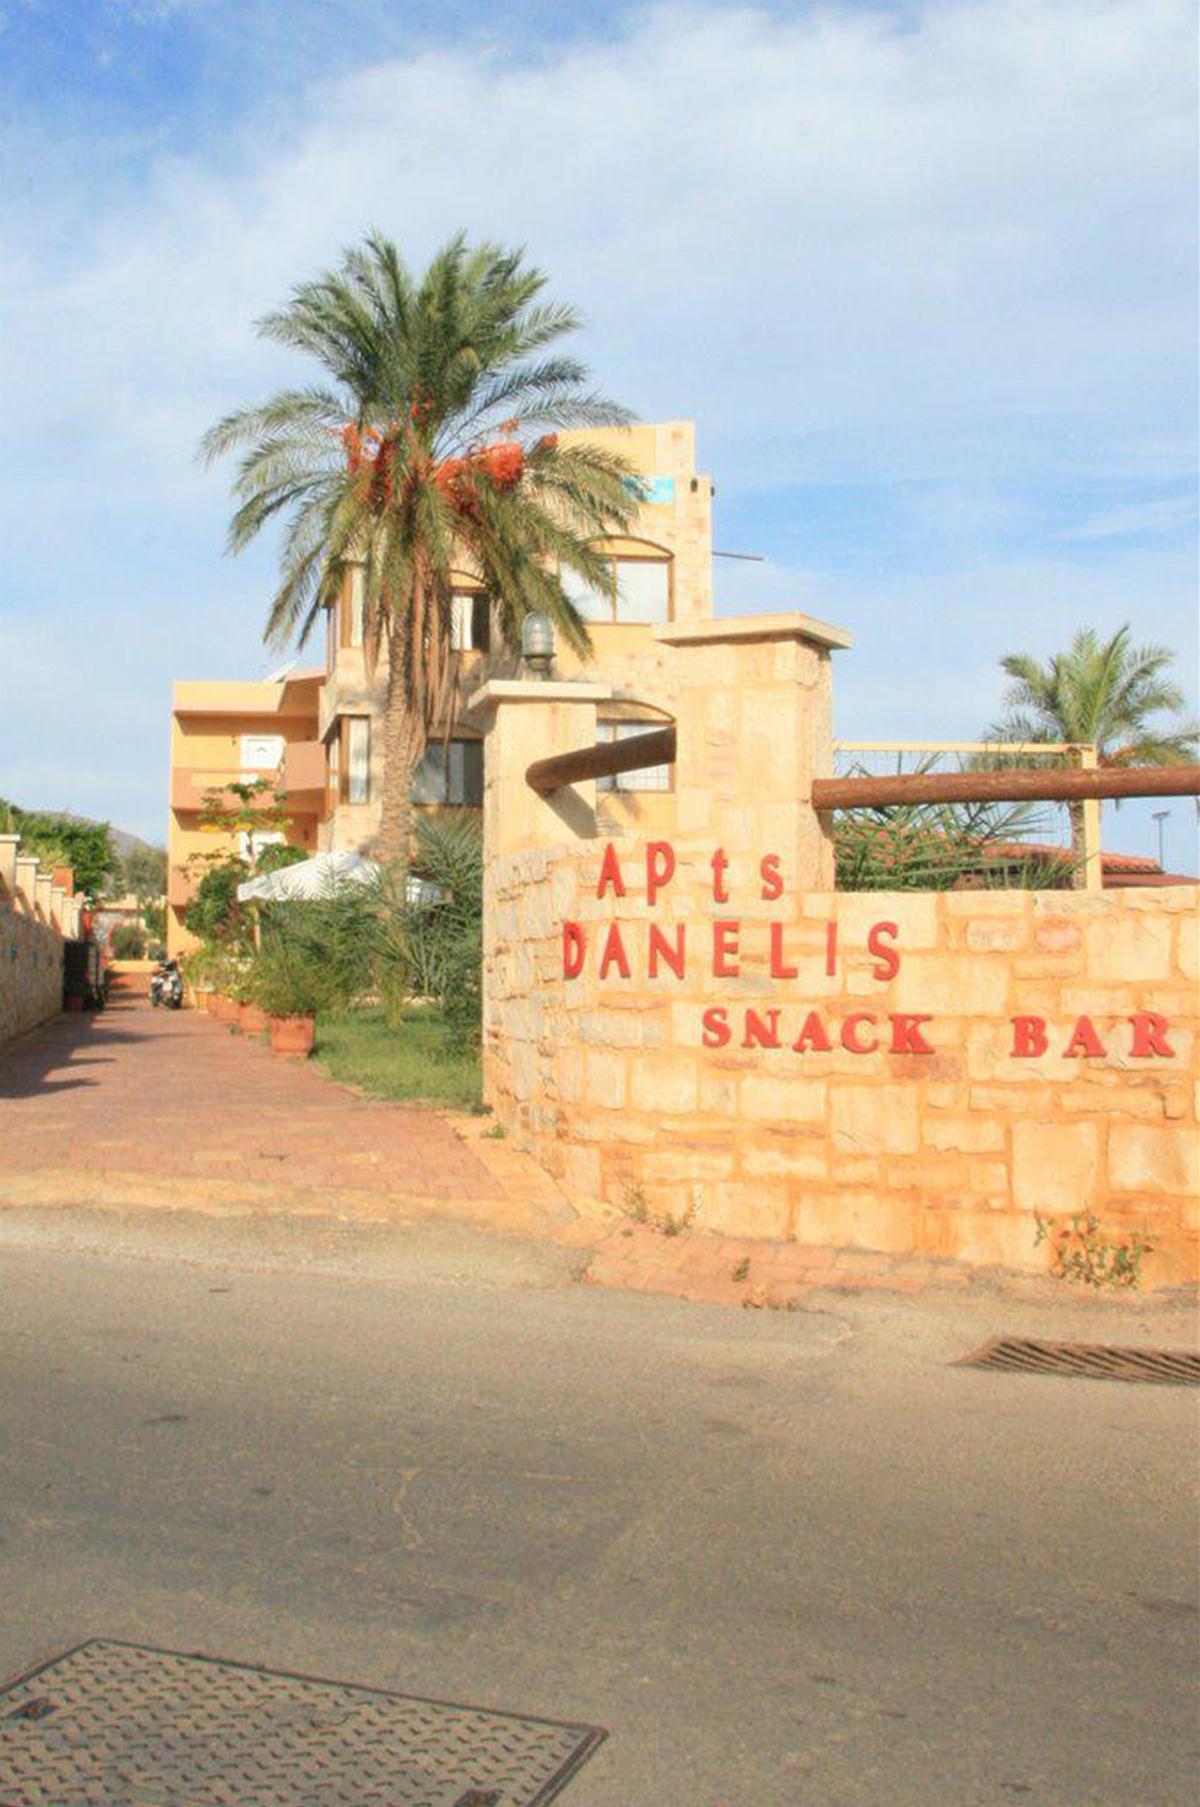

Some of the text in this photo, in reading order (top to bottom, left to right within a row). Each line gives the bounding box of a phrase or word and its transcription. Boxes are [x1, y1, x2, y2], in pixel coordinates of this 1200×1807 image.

[562, 921, 901, 981] DANELIS
[701, 1008, 1176, 1058] SNACK BAR
